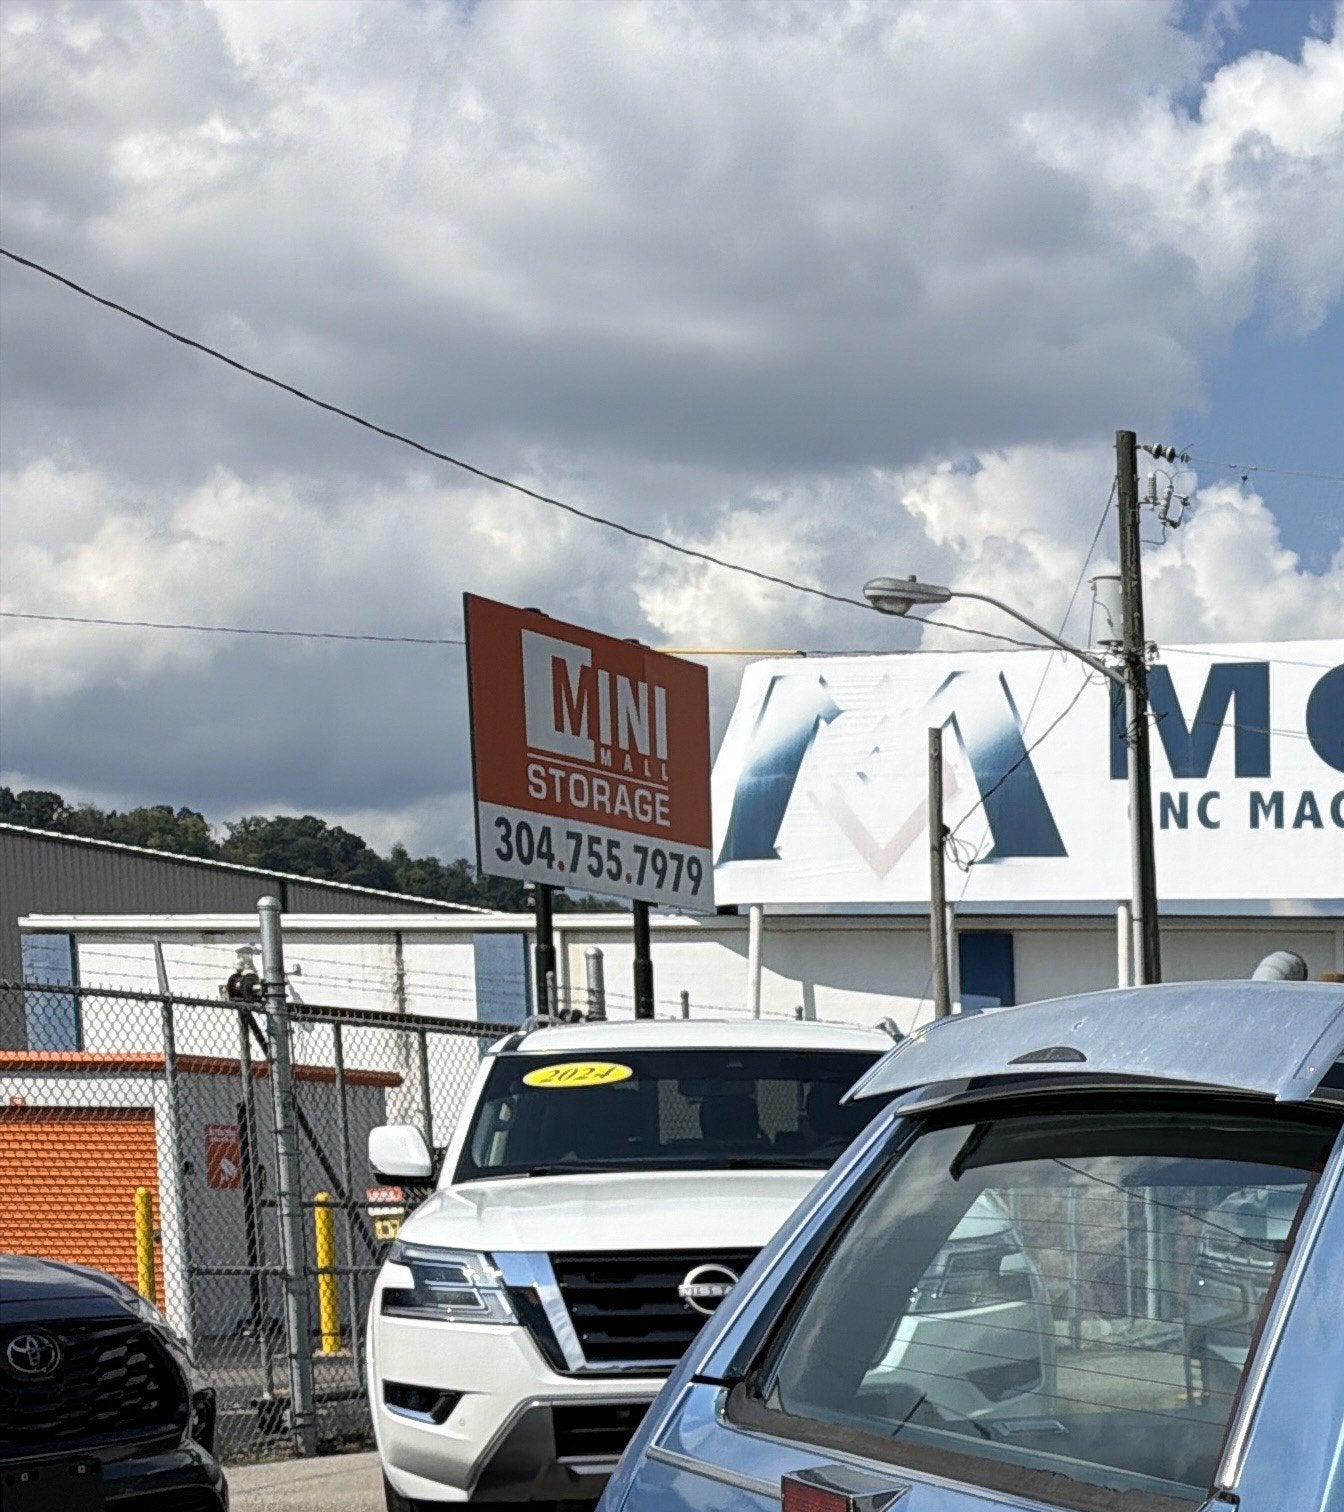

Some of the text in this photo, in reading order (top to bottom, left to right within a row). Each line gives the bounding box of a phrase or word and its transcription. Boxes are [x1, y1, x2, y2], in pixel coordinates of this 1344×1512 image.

[520, 628, 669, 763] MINI
[599, 746, 669, 782] MALL
[526, 762, 671, 828] STORAGE
[1127, 790, 1221, 830] NC
[494, 816, 703, 896] 304.755.7979
[540, 1066, 618, 1084] 2024
